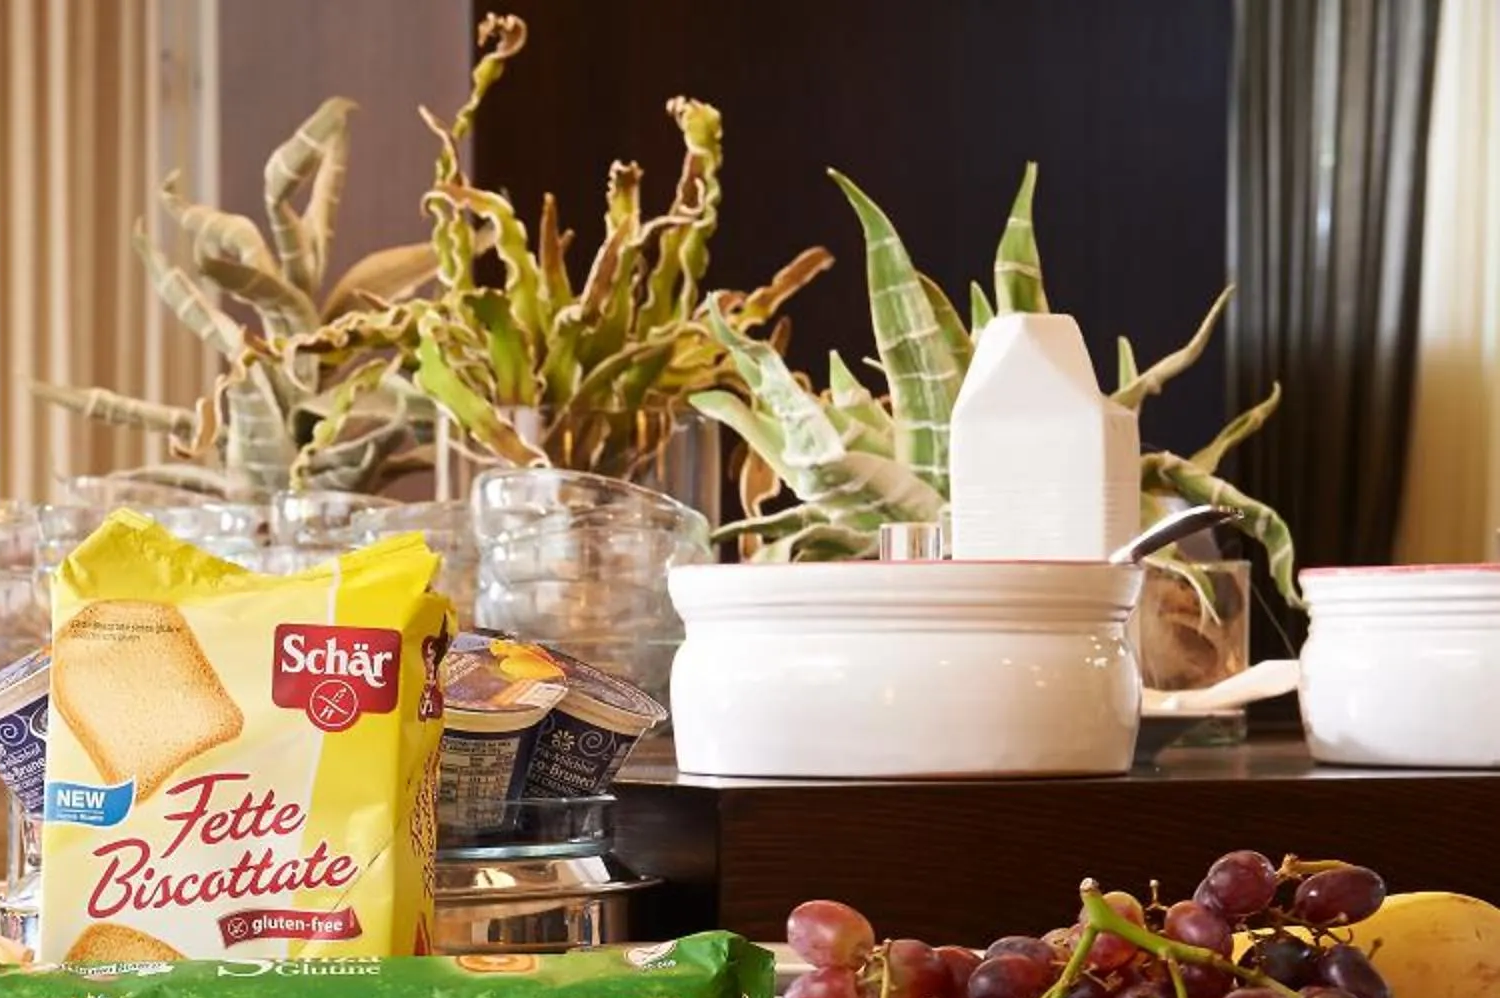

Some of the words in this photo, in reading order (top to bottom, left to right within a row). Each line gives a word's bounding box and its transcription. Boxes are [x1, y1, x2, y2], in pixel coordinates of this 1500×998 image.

[281, 633, 393, 688] Schär
[56, 789, 106, 809] NEW
[161, 774, 306, 859] Fette
[88, 839, 358, 919] Biscottate
[251, 916, 344, 935] gluten-free
